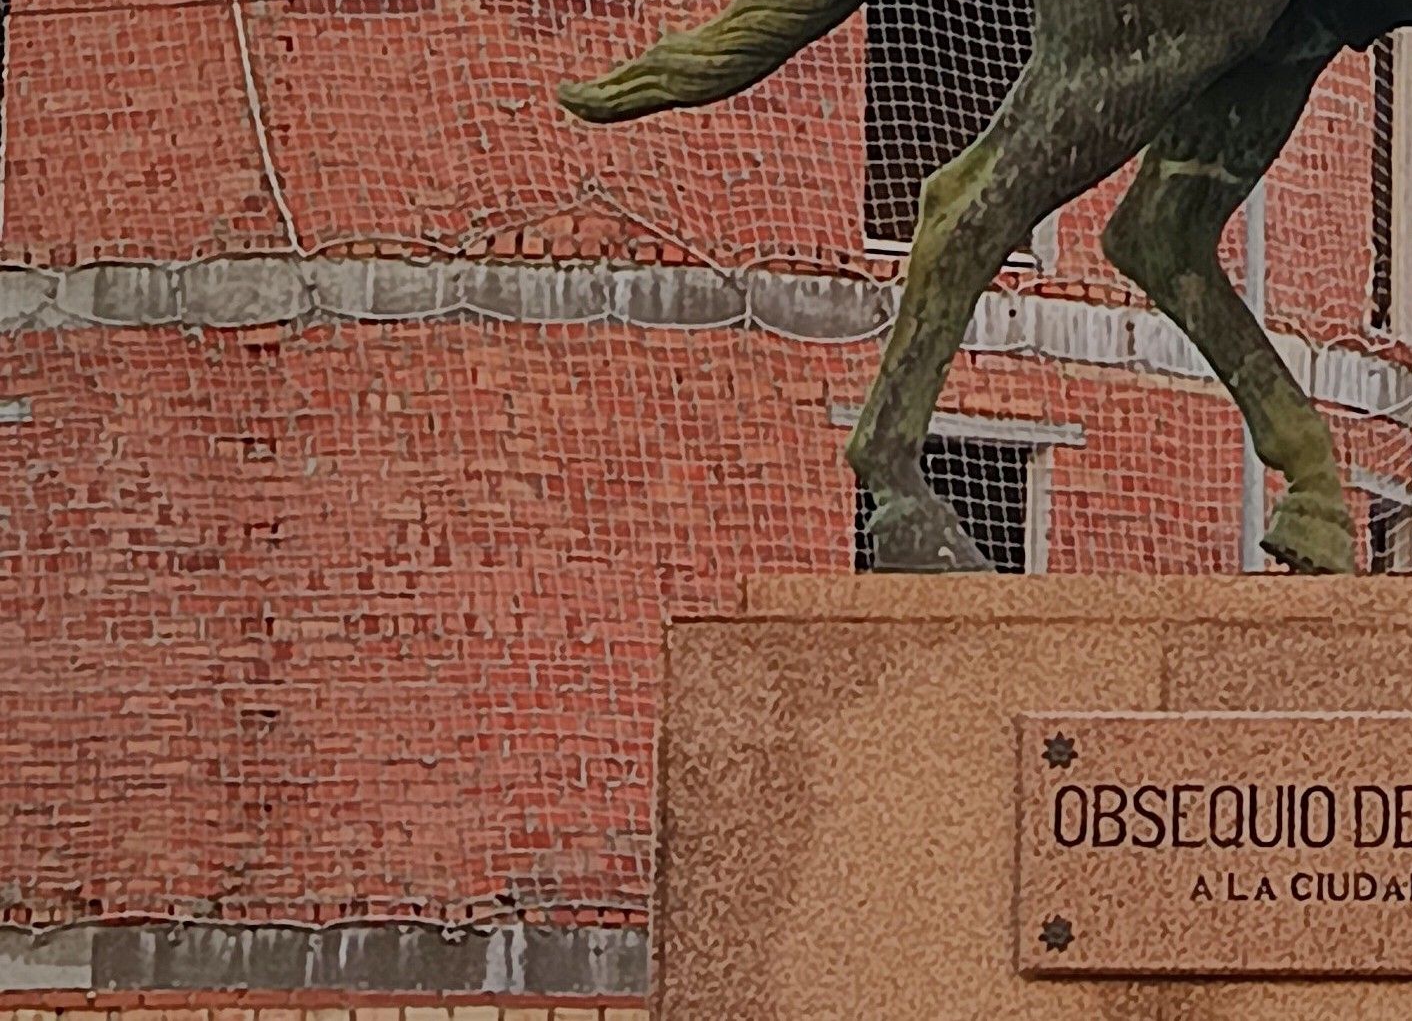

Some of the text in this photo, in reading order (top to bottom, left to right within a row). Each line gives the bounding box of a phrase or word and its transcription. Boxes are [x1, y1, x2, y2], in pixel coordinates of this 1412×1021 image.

[1053, 785, 1336, 848] OBSEQUIO
[1190, 874, 1213, 901] A
[1227, 872, 1277, 901] LA
